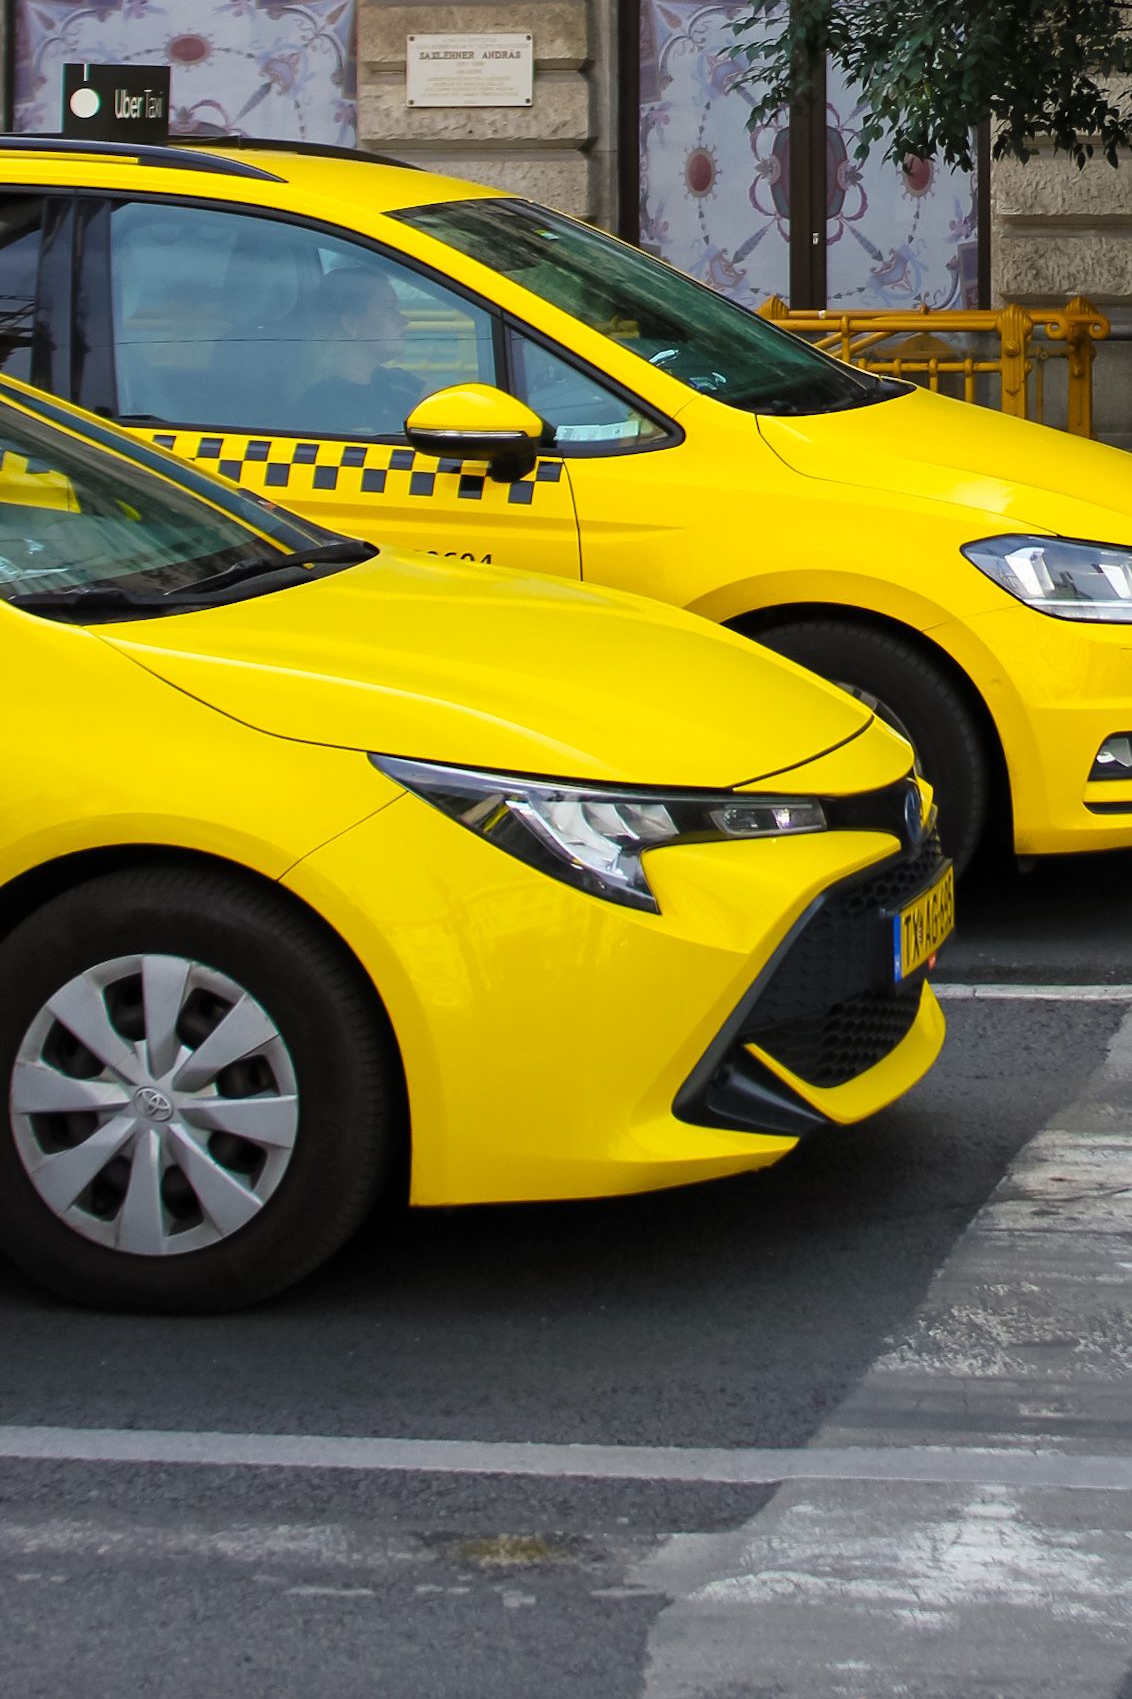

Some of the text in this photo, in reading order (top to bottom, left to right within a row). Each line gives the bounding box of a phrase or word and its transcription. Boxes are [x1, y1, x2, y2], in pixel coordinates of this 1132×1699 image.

[419, 51, 475, 60] SAXLEHNER
[114, 88, 164, 119] Uber Taxi
